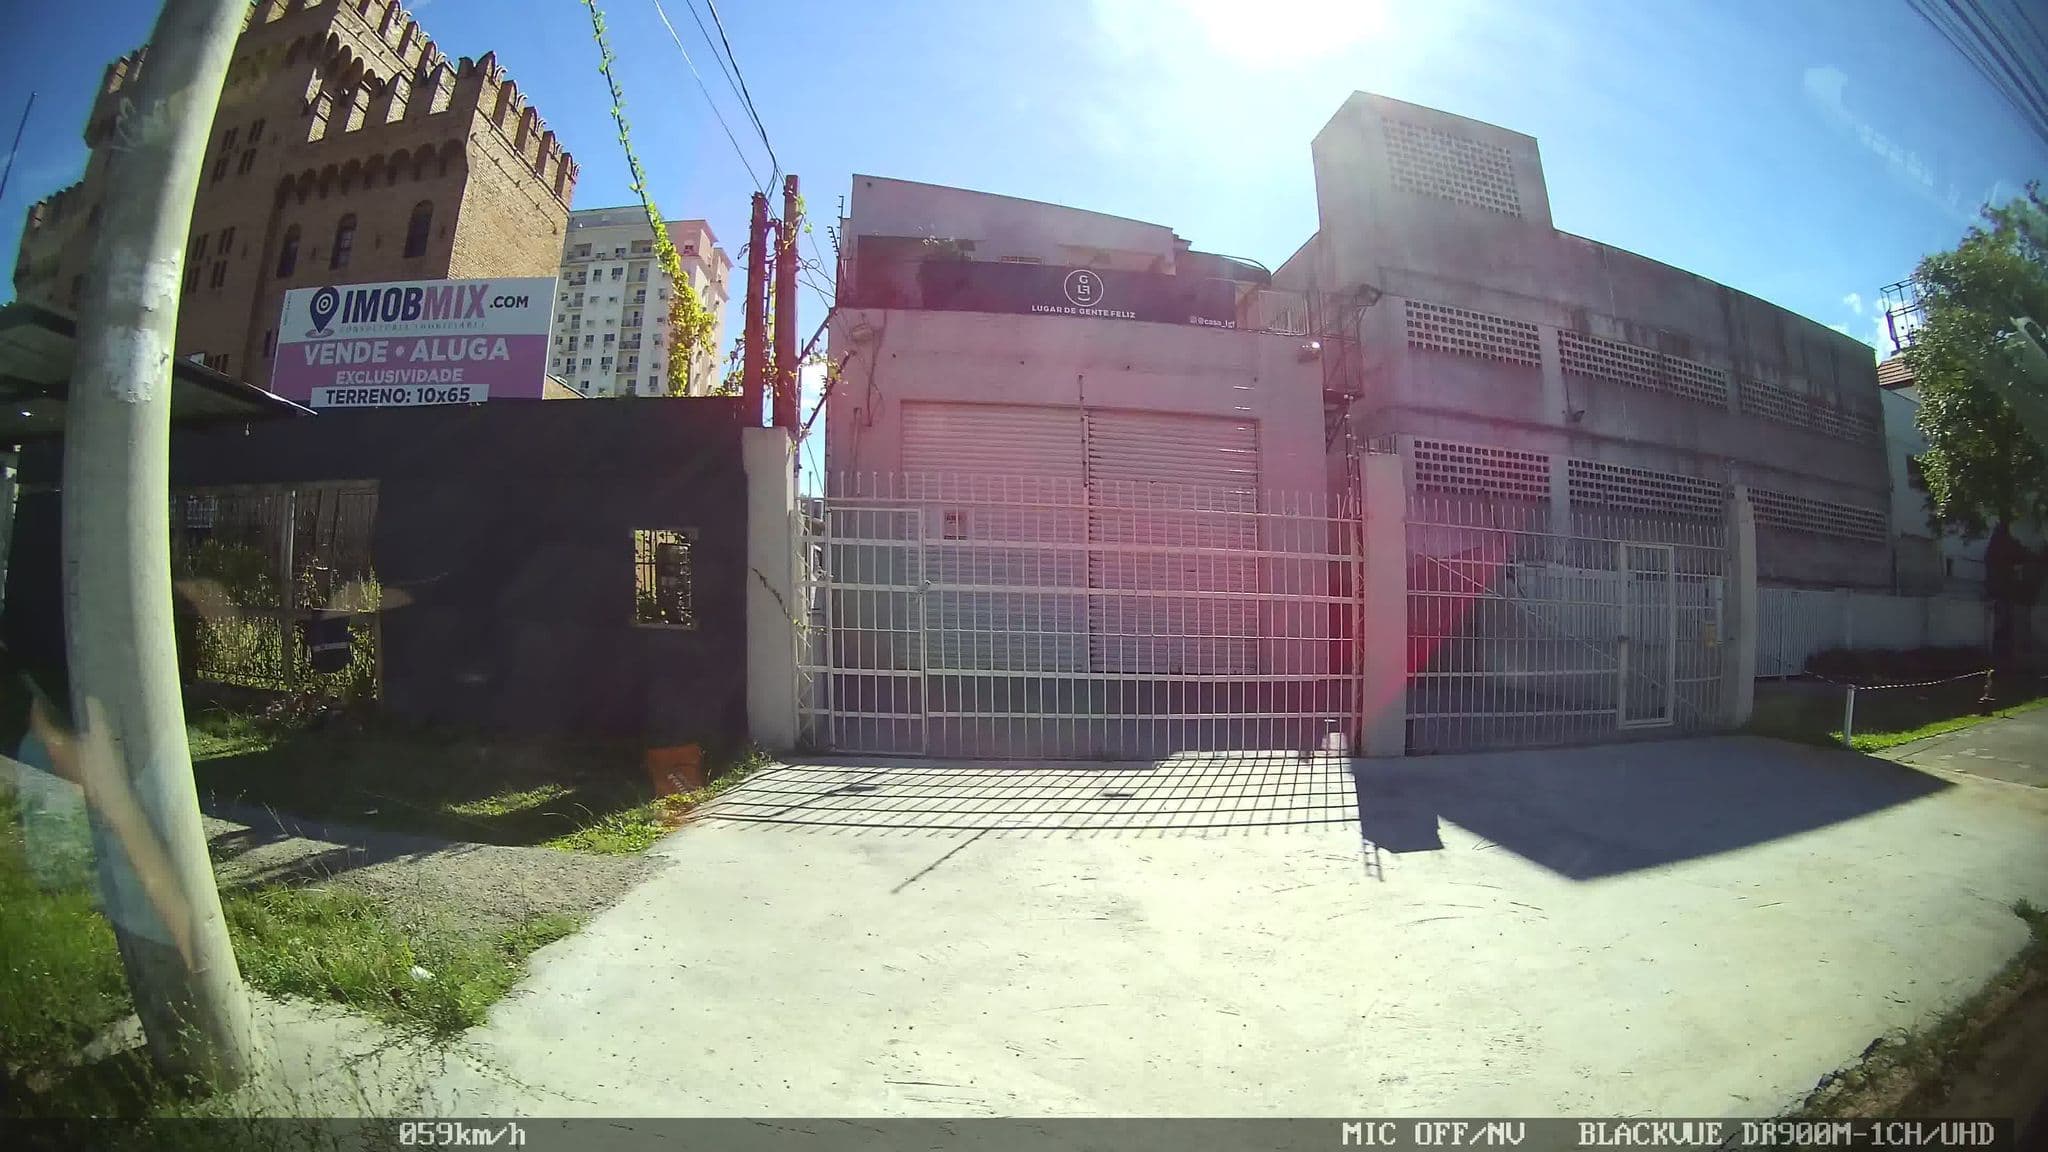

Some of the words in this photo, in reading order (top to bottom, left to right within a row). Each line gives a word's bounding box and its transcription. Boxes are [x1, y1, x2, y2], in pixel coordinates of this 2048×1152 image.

[341, 284, 488, 324] IMOBMIX
[1031, 304, 1062, 313] LUGAR
[1064, 306, 1076, 314] DE
[1079, 307, 1109, 317] GENTE
[1110, 310, 1136, 319] FELIZ
[304, 340, 389, 366] VENDE
[409, 337, 510, 362] ALUGA
[336, 367, 464, 385] EXCLUSIVIDADE
[326, 390, 411, 405] TERRENO:
[417, 386, 471, 403] 10x65
